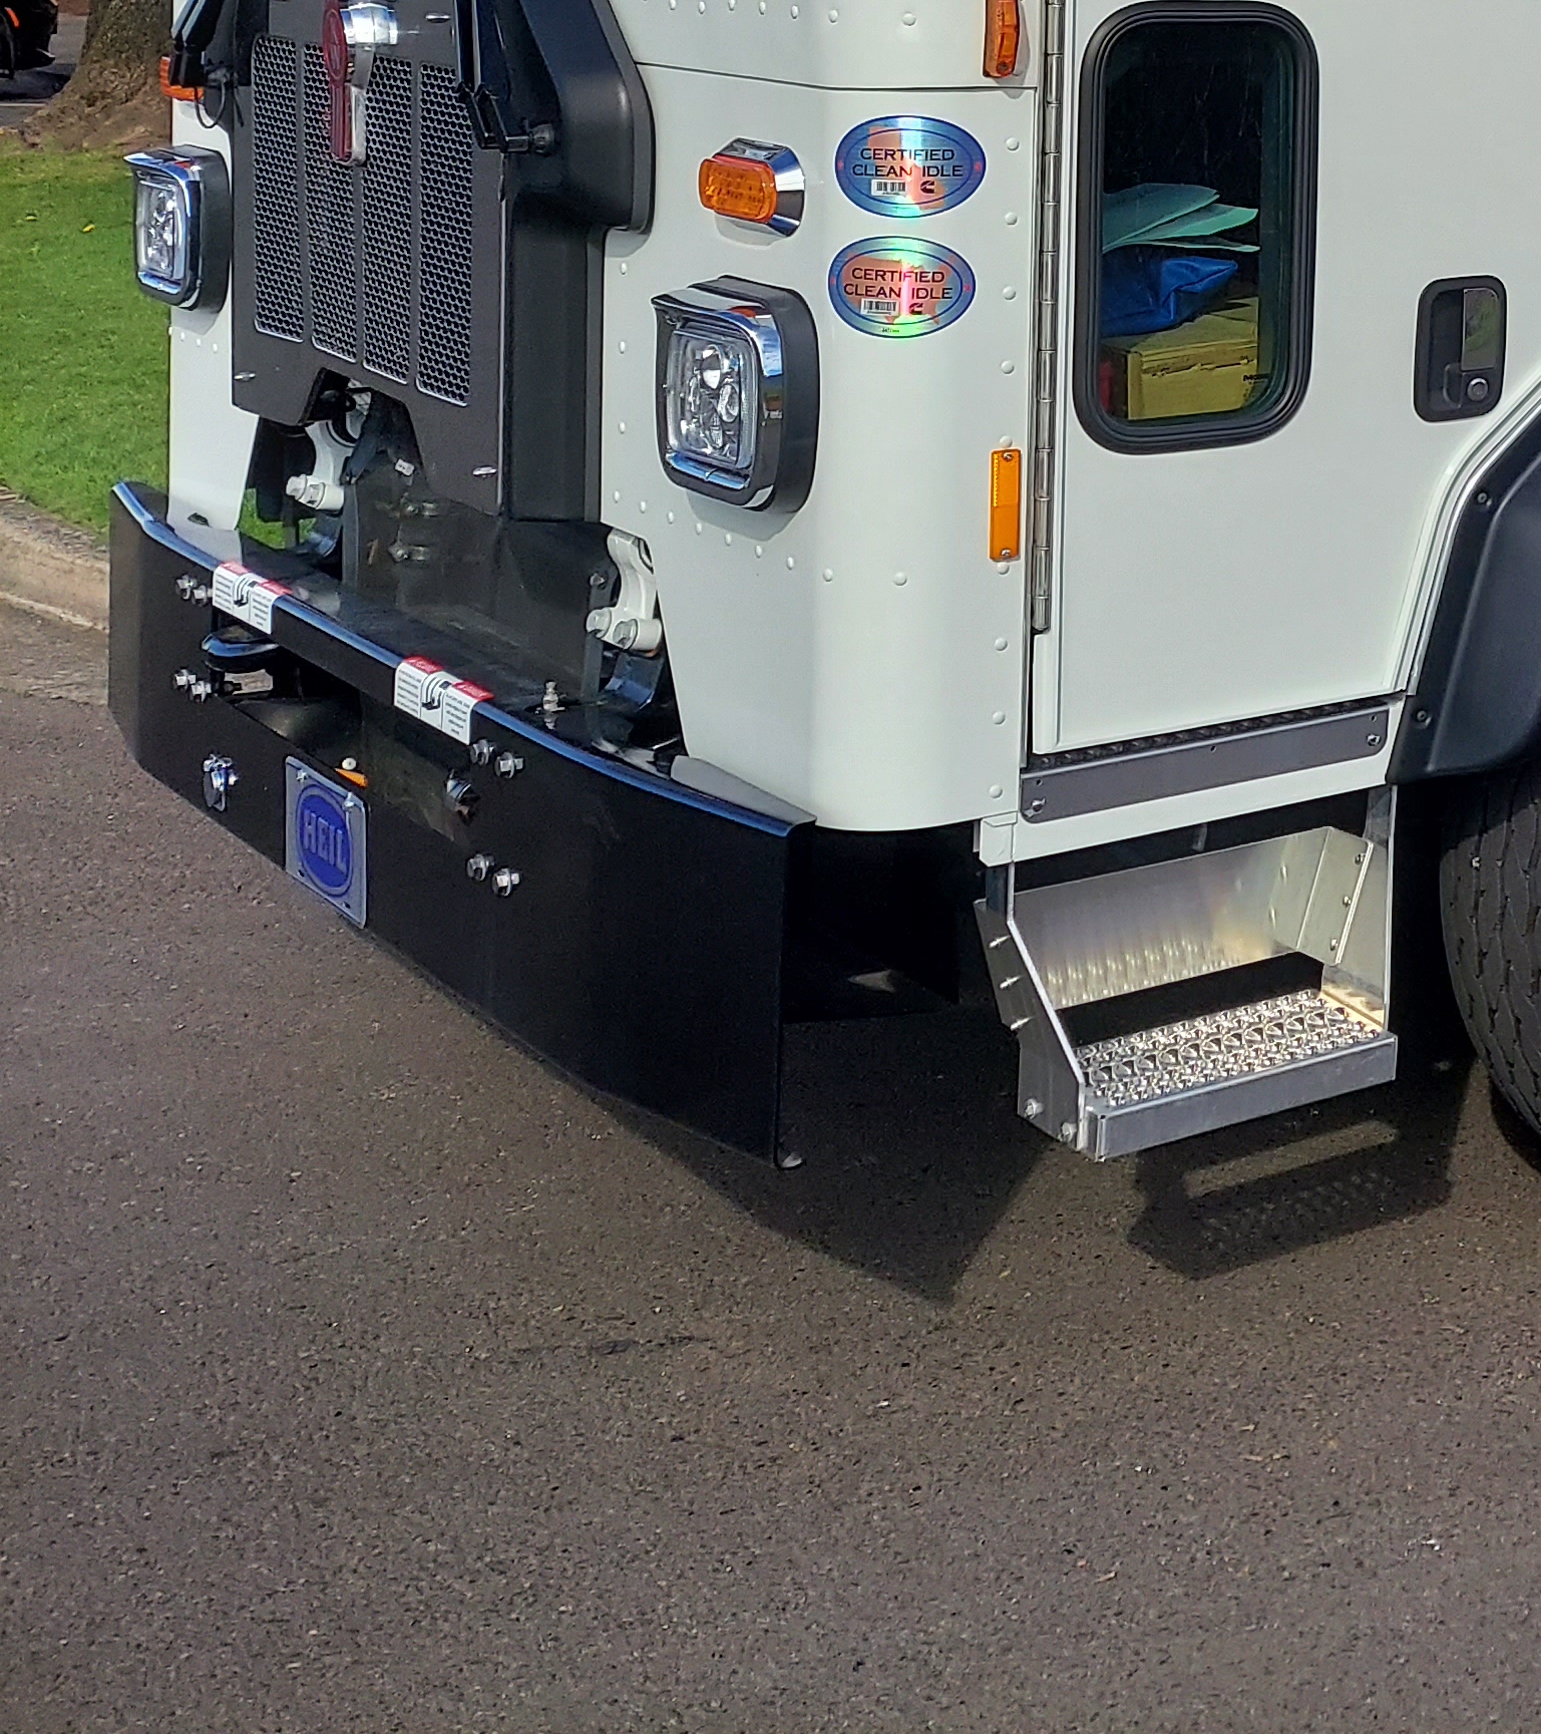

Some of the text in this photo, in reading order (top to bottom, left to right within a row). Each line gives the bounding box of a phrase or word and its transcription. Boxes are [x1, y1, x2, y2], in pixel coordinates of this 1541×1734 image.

[860, 148, 955, 161] CERTIFIED
[852, 164, 964, 177] CLEAN IDLE
[851, 267, 945, 283] CERTIFIED
[843, 283, 953, 300] CLEAN IDLE
[303, 809, 348, 874] HEIL
